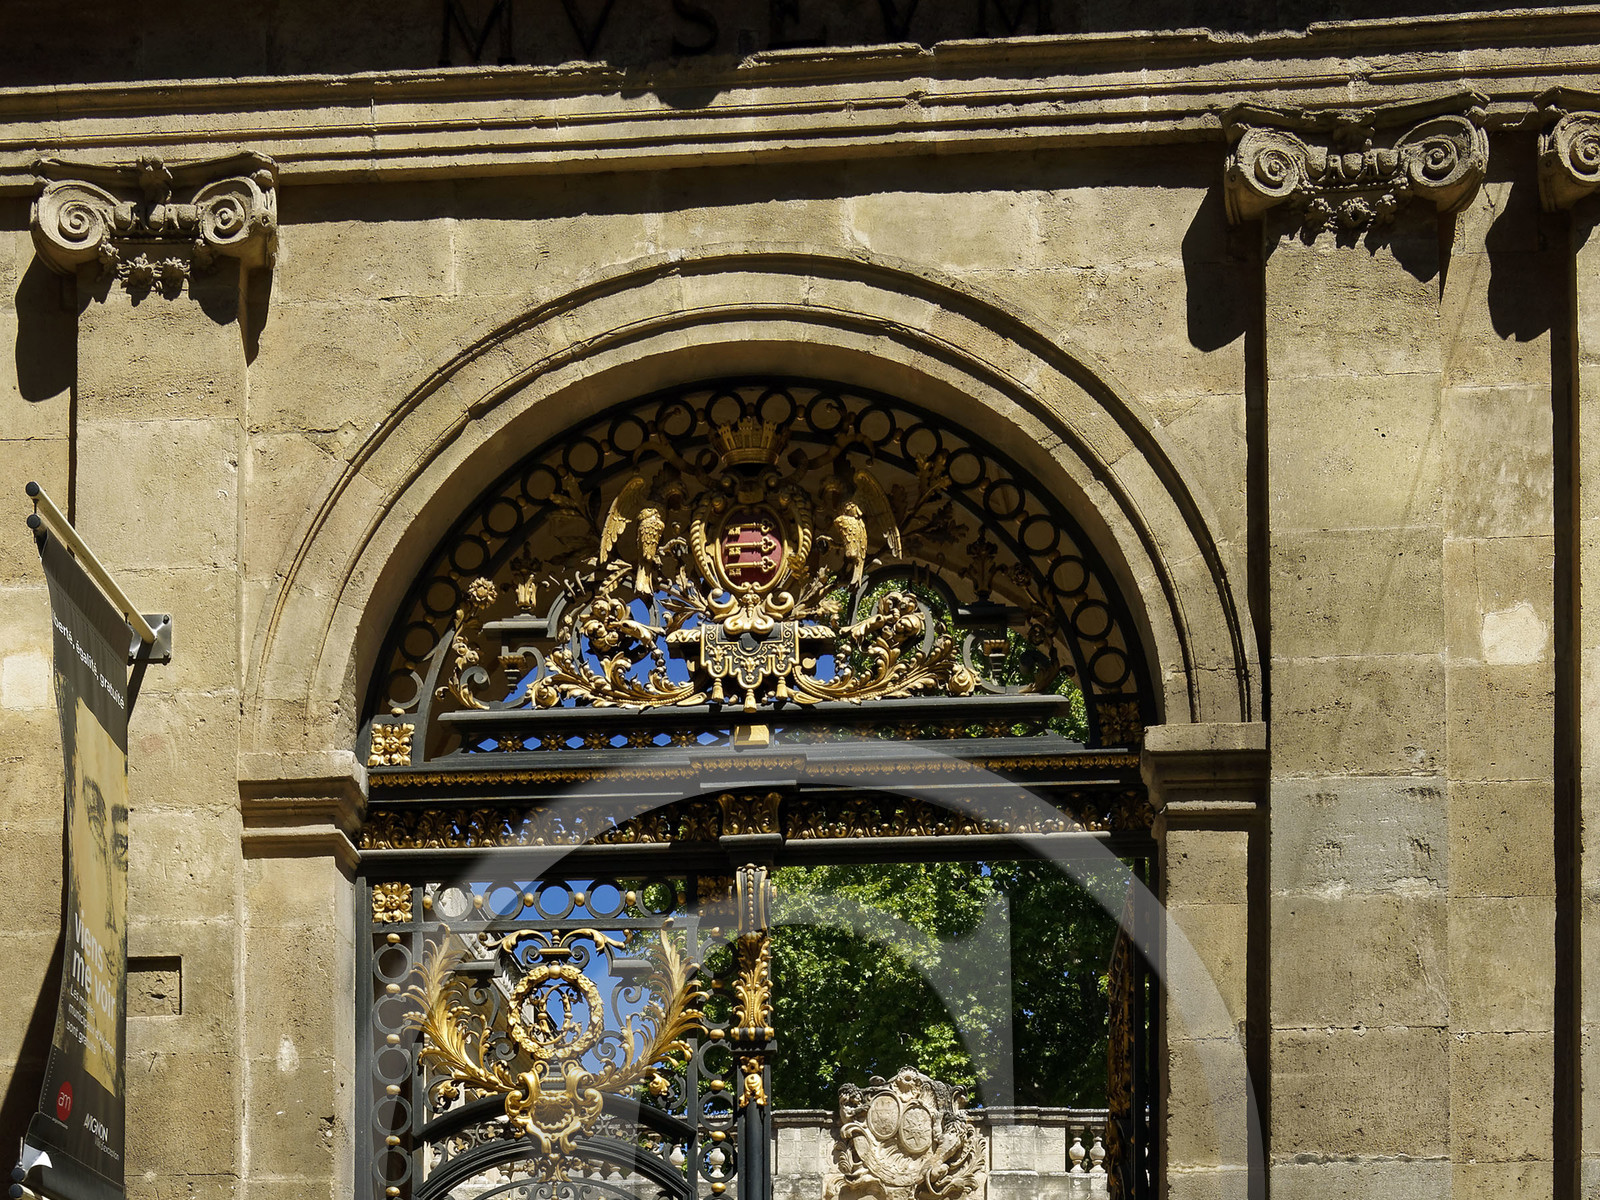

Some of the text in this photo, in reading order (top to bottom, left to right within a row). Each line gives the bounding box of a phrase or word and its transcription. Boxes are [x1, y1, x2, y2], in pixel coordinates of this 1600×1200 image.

[99, 673, 125, 709] gratuité
[74, 909, 104, 973] viens
[72, 949, 92, 994] me
[94, 974, 116, 1022] voir
